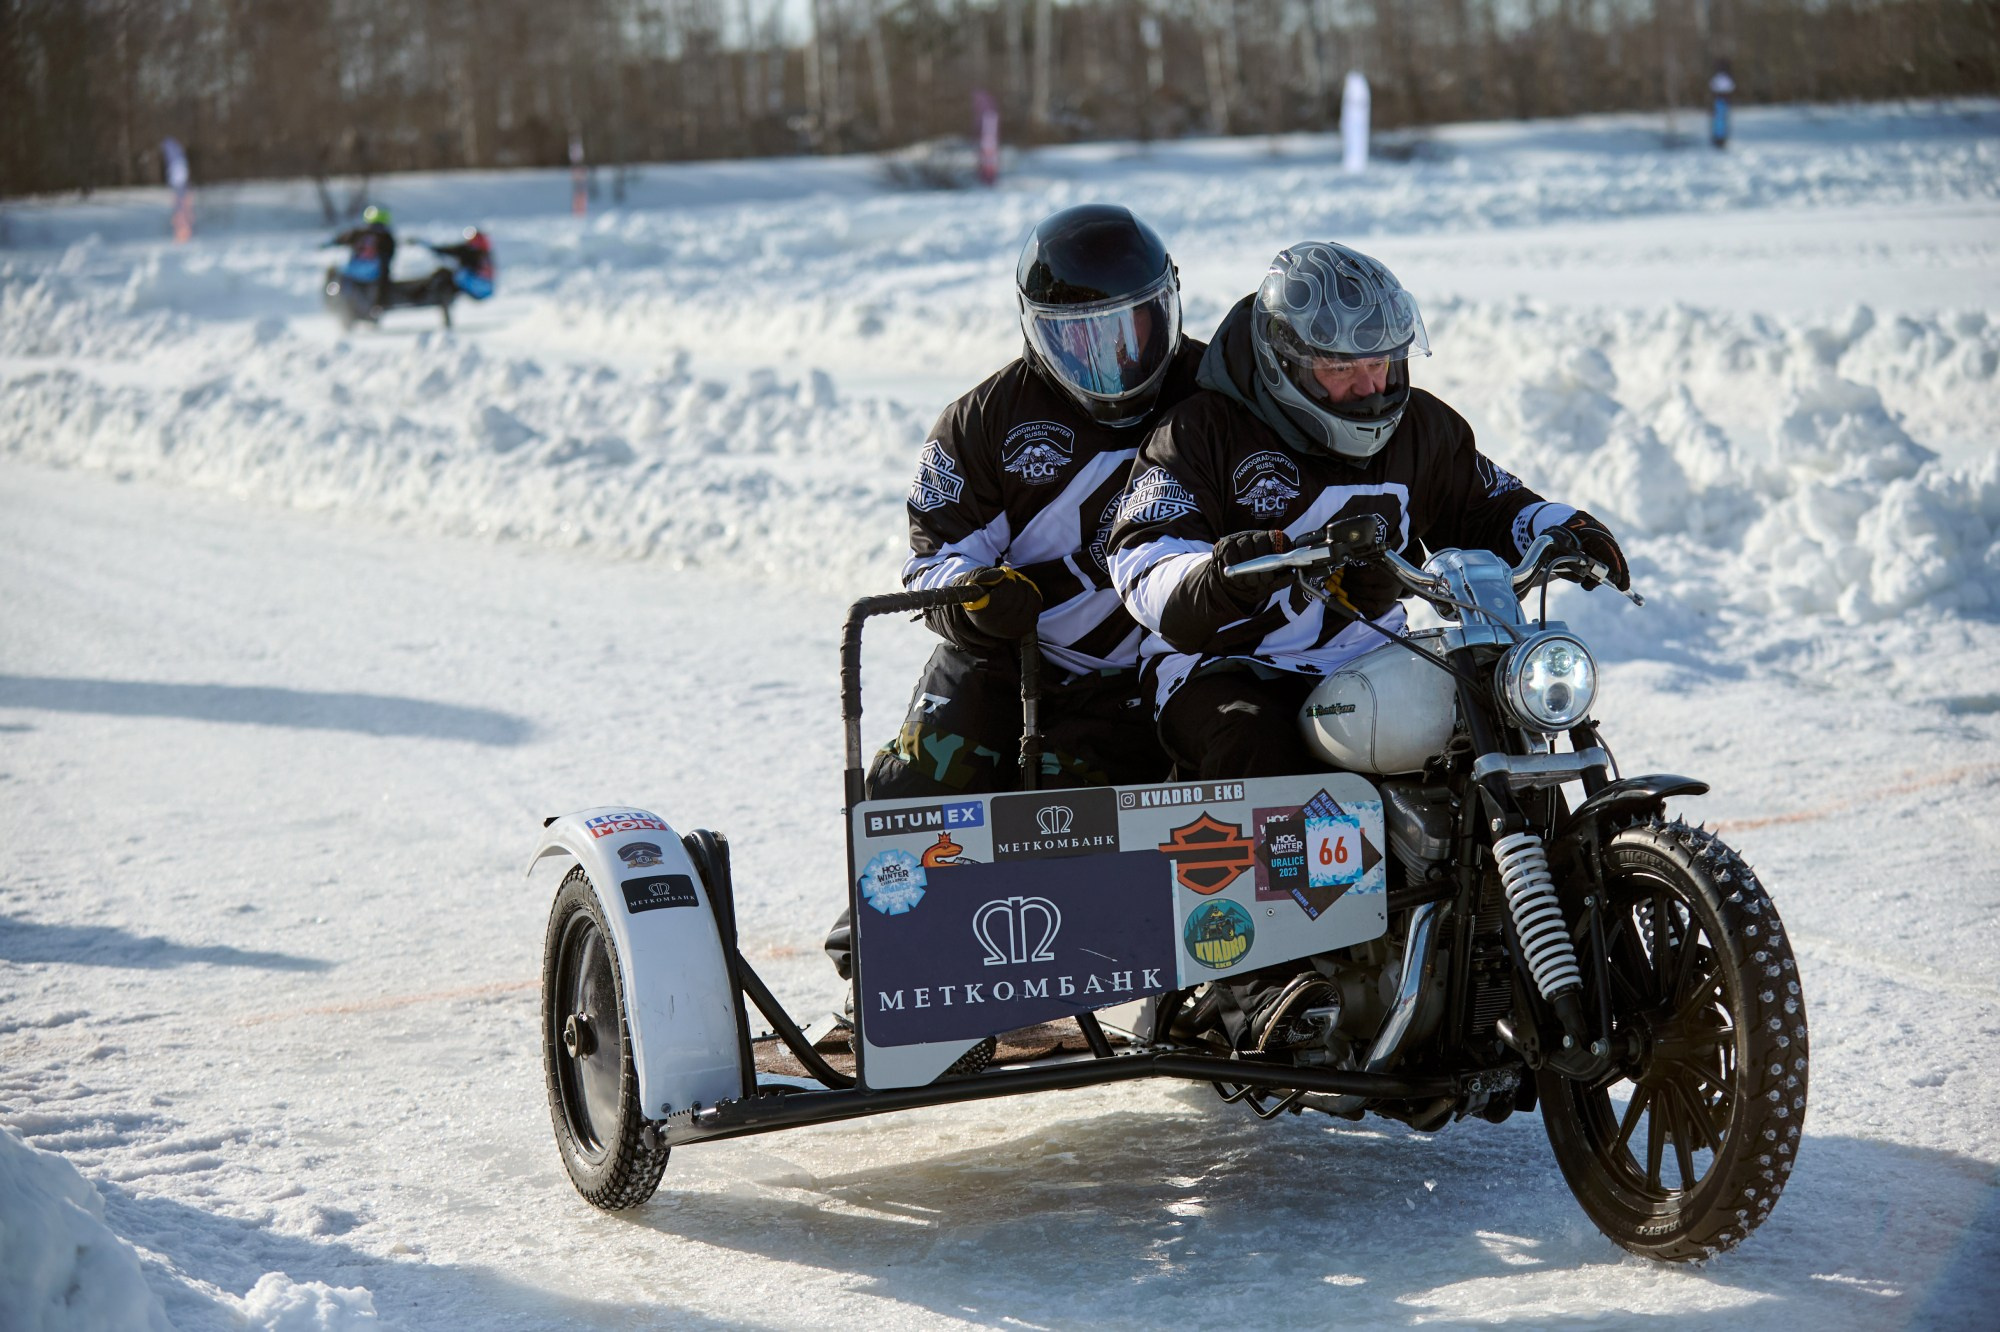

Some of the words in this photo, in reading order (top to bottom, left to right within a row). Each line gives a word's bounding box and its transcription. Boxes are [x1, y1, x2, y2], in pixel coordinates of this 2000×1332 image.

[1024, 431, 1048, 440] RUSSIA
[1041, 424, 1071, 439] CHAPTER
[1022, 461, 1055, 479] HOG
[1254, 496, 1285, 512] HOG
[1140, 784, 1244, 807] KVADRO_EKB
[870, 807, 976, 831] BITUMEX
[594, 820, 662, 836] MOLY
[998, 834, 1116, 854] МЕТКОМБАНК
[1270, 840, 1304, 854] WINTER
[1319, 836, 1348, 866] 66
[882, 864, 902, 875] HOG
[1271, 856, 1305, 868] URALICE
[877, 869, 909, 883] WINTER
[1279, 867, 1298, 878] 2023
[630, 895, 695, 907] МЕТКОМБАНК
[1195, 935, 1247, 963] KVADRO
[878, 968, 1163, 1012] МЕТКОМБАНК
